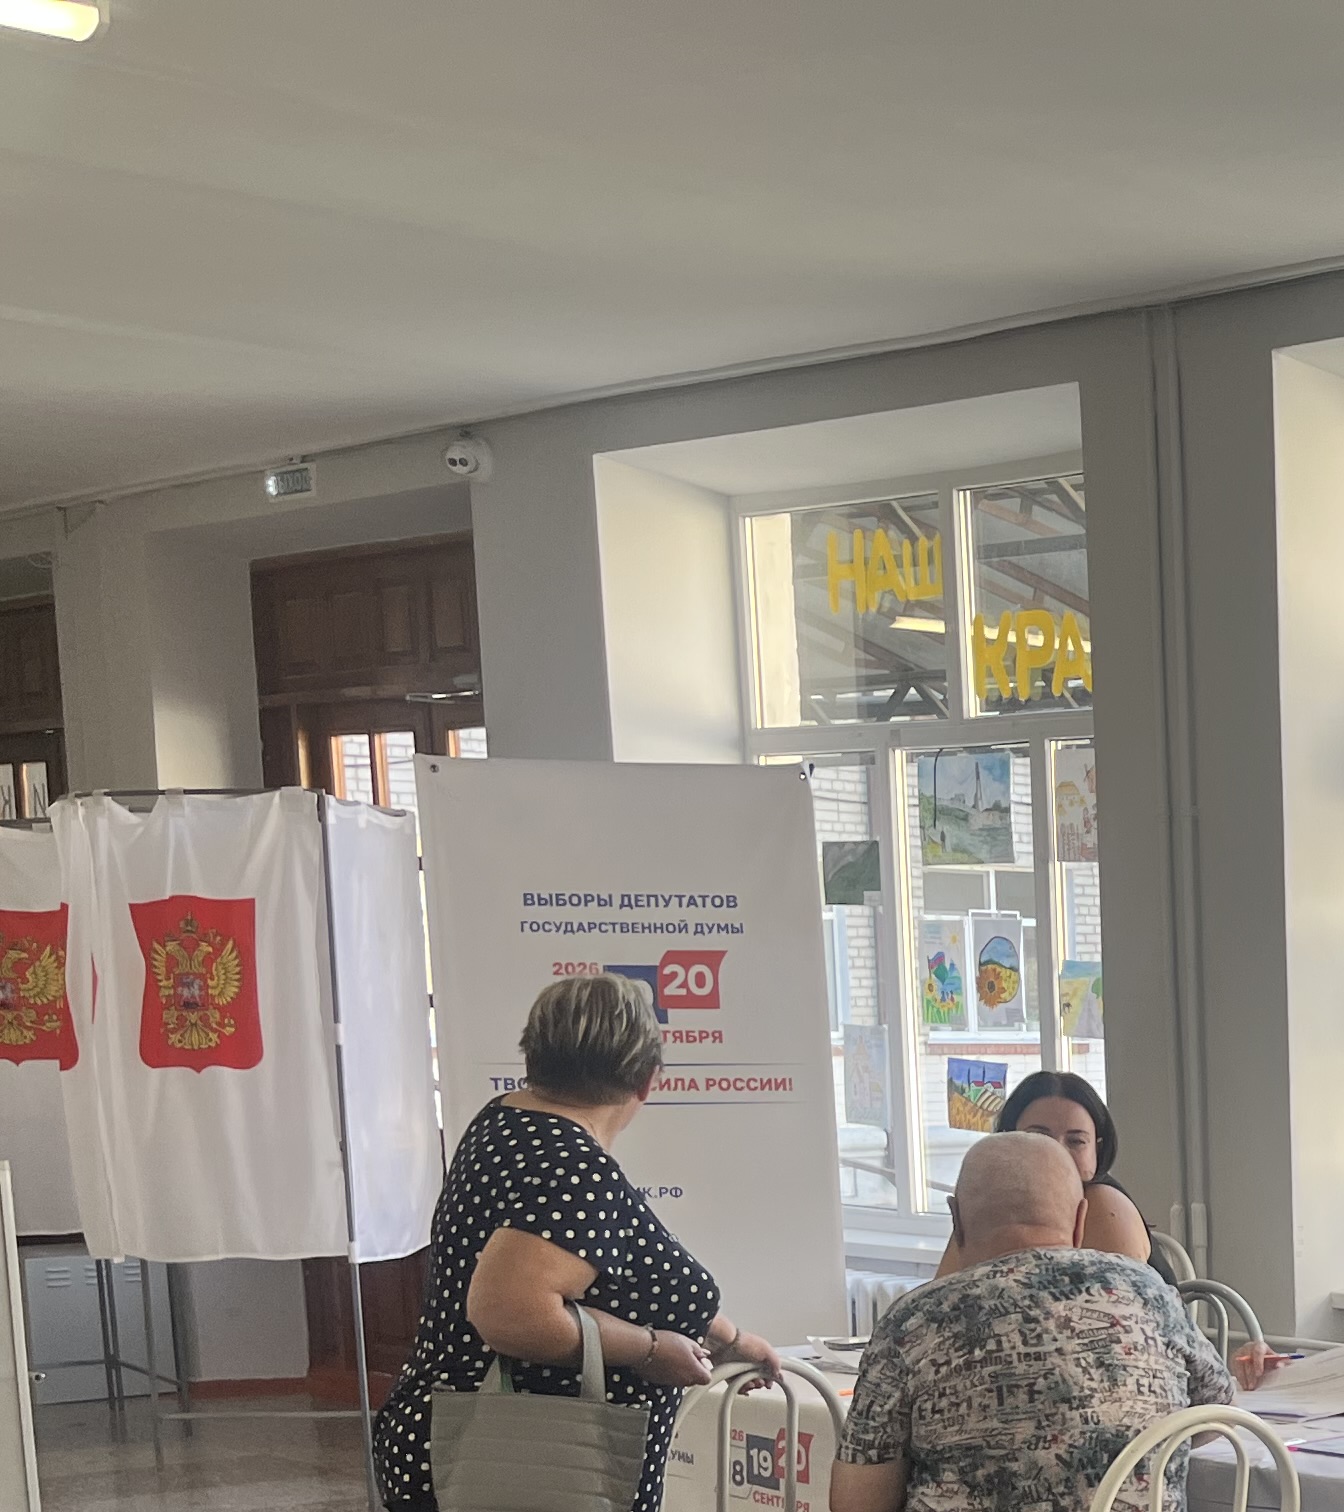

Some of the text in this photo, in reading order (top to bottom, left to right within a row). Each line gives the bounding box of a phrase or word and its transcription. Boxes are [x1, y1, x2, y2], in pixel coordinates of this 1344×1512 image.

[826, 528, 943, 614] НАШ
[522, 892, 739, 911] ВЫБОРЫ ДЕПУТАТОВ
[519, 918, 745, 937] ГОСУДАРСТВЕННОЙ ДУМЫ
[551, 961, 600, 977] 2026
[662, 963, 714, 997] 20
[650, 1077, 700, 1093] ИЛА
[704, 1077, 794, 1093] РОССИИ!
[668, 1450, 695, 1466] УМЫ
[750, 1448, 773, 1478] 19
